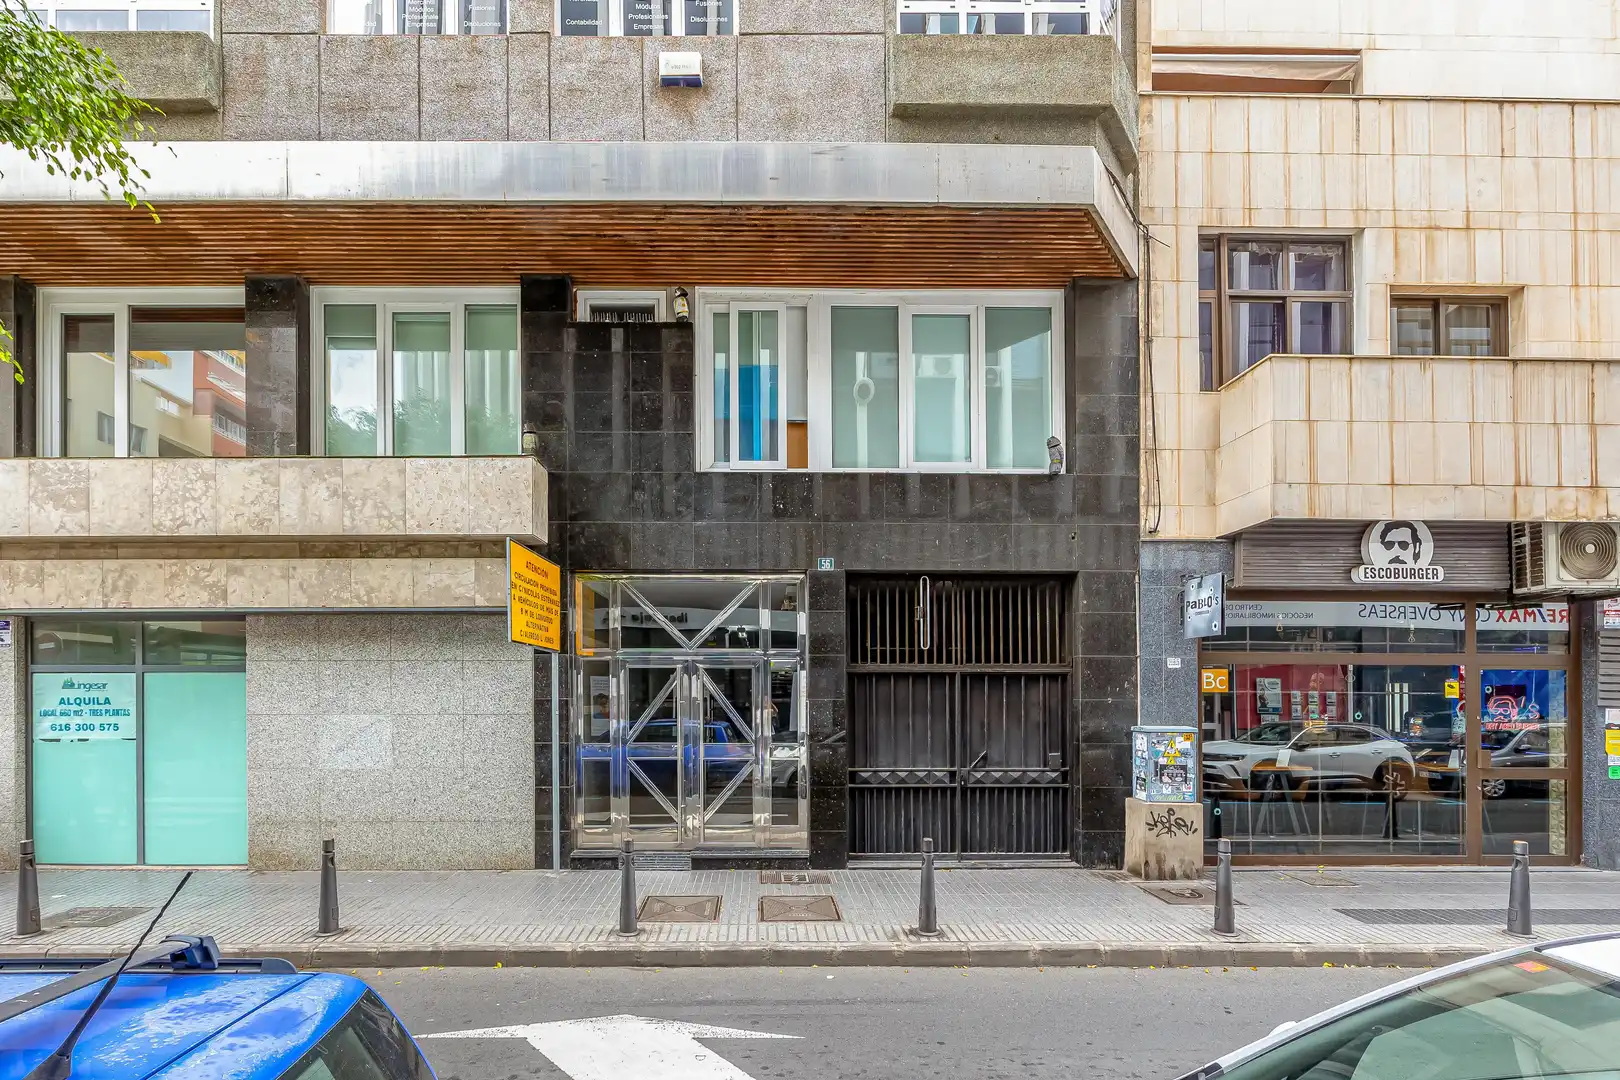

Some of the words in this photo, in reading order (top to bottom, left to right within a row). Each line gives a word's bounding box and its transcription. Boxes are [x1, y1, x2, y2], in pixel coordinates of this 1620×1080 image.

[821, 559, 830, 569] 56
[1364, 567, 1439, 580] ESCOBURGER
[512, 581, 518, 590] EN
[540, 604, 545, 612] DE
[530, 610, 535, 618] DE
[1203, 672, 1227, 689] Bc
[78, 680, 108, 692] ingesar
[58, 697, 112, 706] ALQUILA
[40, 709, 57, 717] LOCAL
[50, 723, 71, 731] 616
[75, 723, 95, 731] 300
[99, 723, 119, 731] 575
